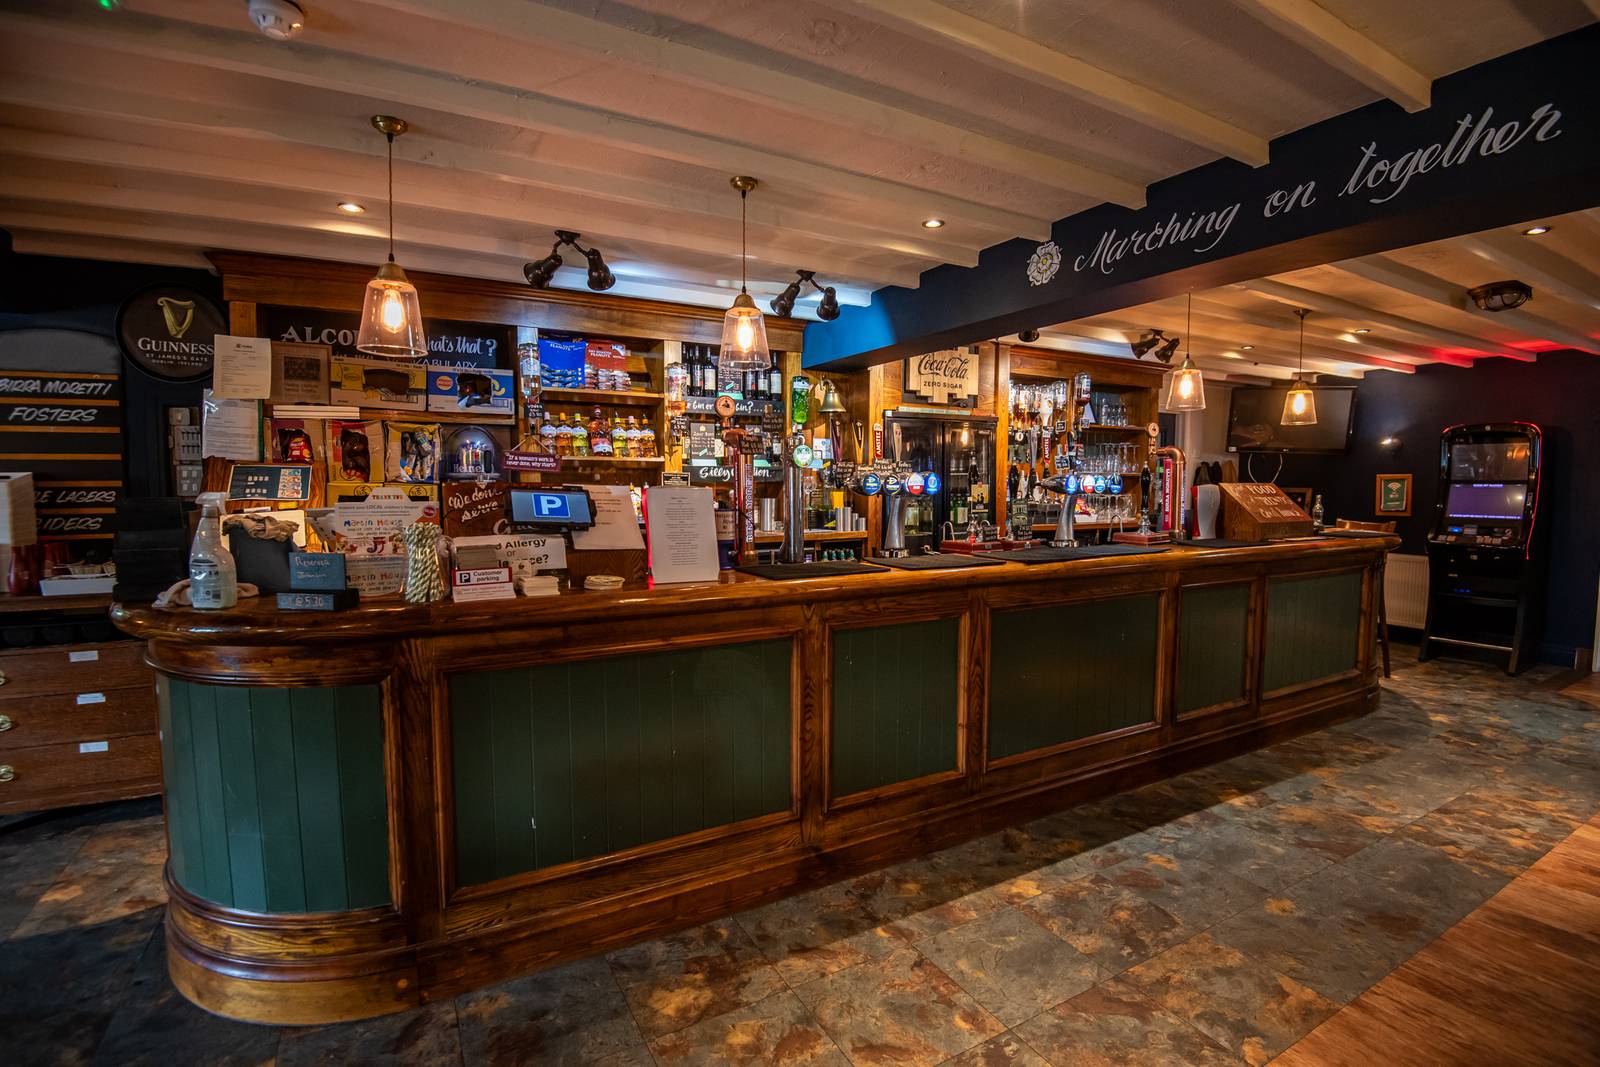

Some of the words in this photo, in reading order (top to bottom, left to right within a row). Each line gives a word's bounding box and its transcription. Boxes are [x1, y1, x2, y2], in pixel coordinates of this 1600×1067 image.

[1075, 202, 1240, 274] Marching
[1264, 179, 1315, 218] on
[1338, 103, 1562, 204] together
[280, 325, 359, 347] ALCO
[138, 337, 214, 355] GUINNESS
[0, 379, 41, 392] BIRRA
[43, 381, 112, 395] MORETTI
[8, 407, 98, 422] FOSTERS
[699, 466, 731, 481] Silly
[55, 490, 117, 503] LAGERS
[505, 538, 547, 549] Allergy
[506, 550, 516, 558] or
[476, 575, 500, 583] parking
